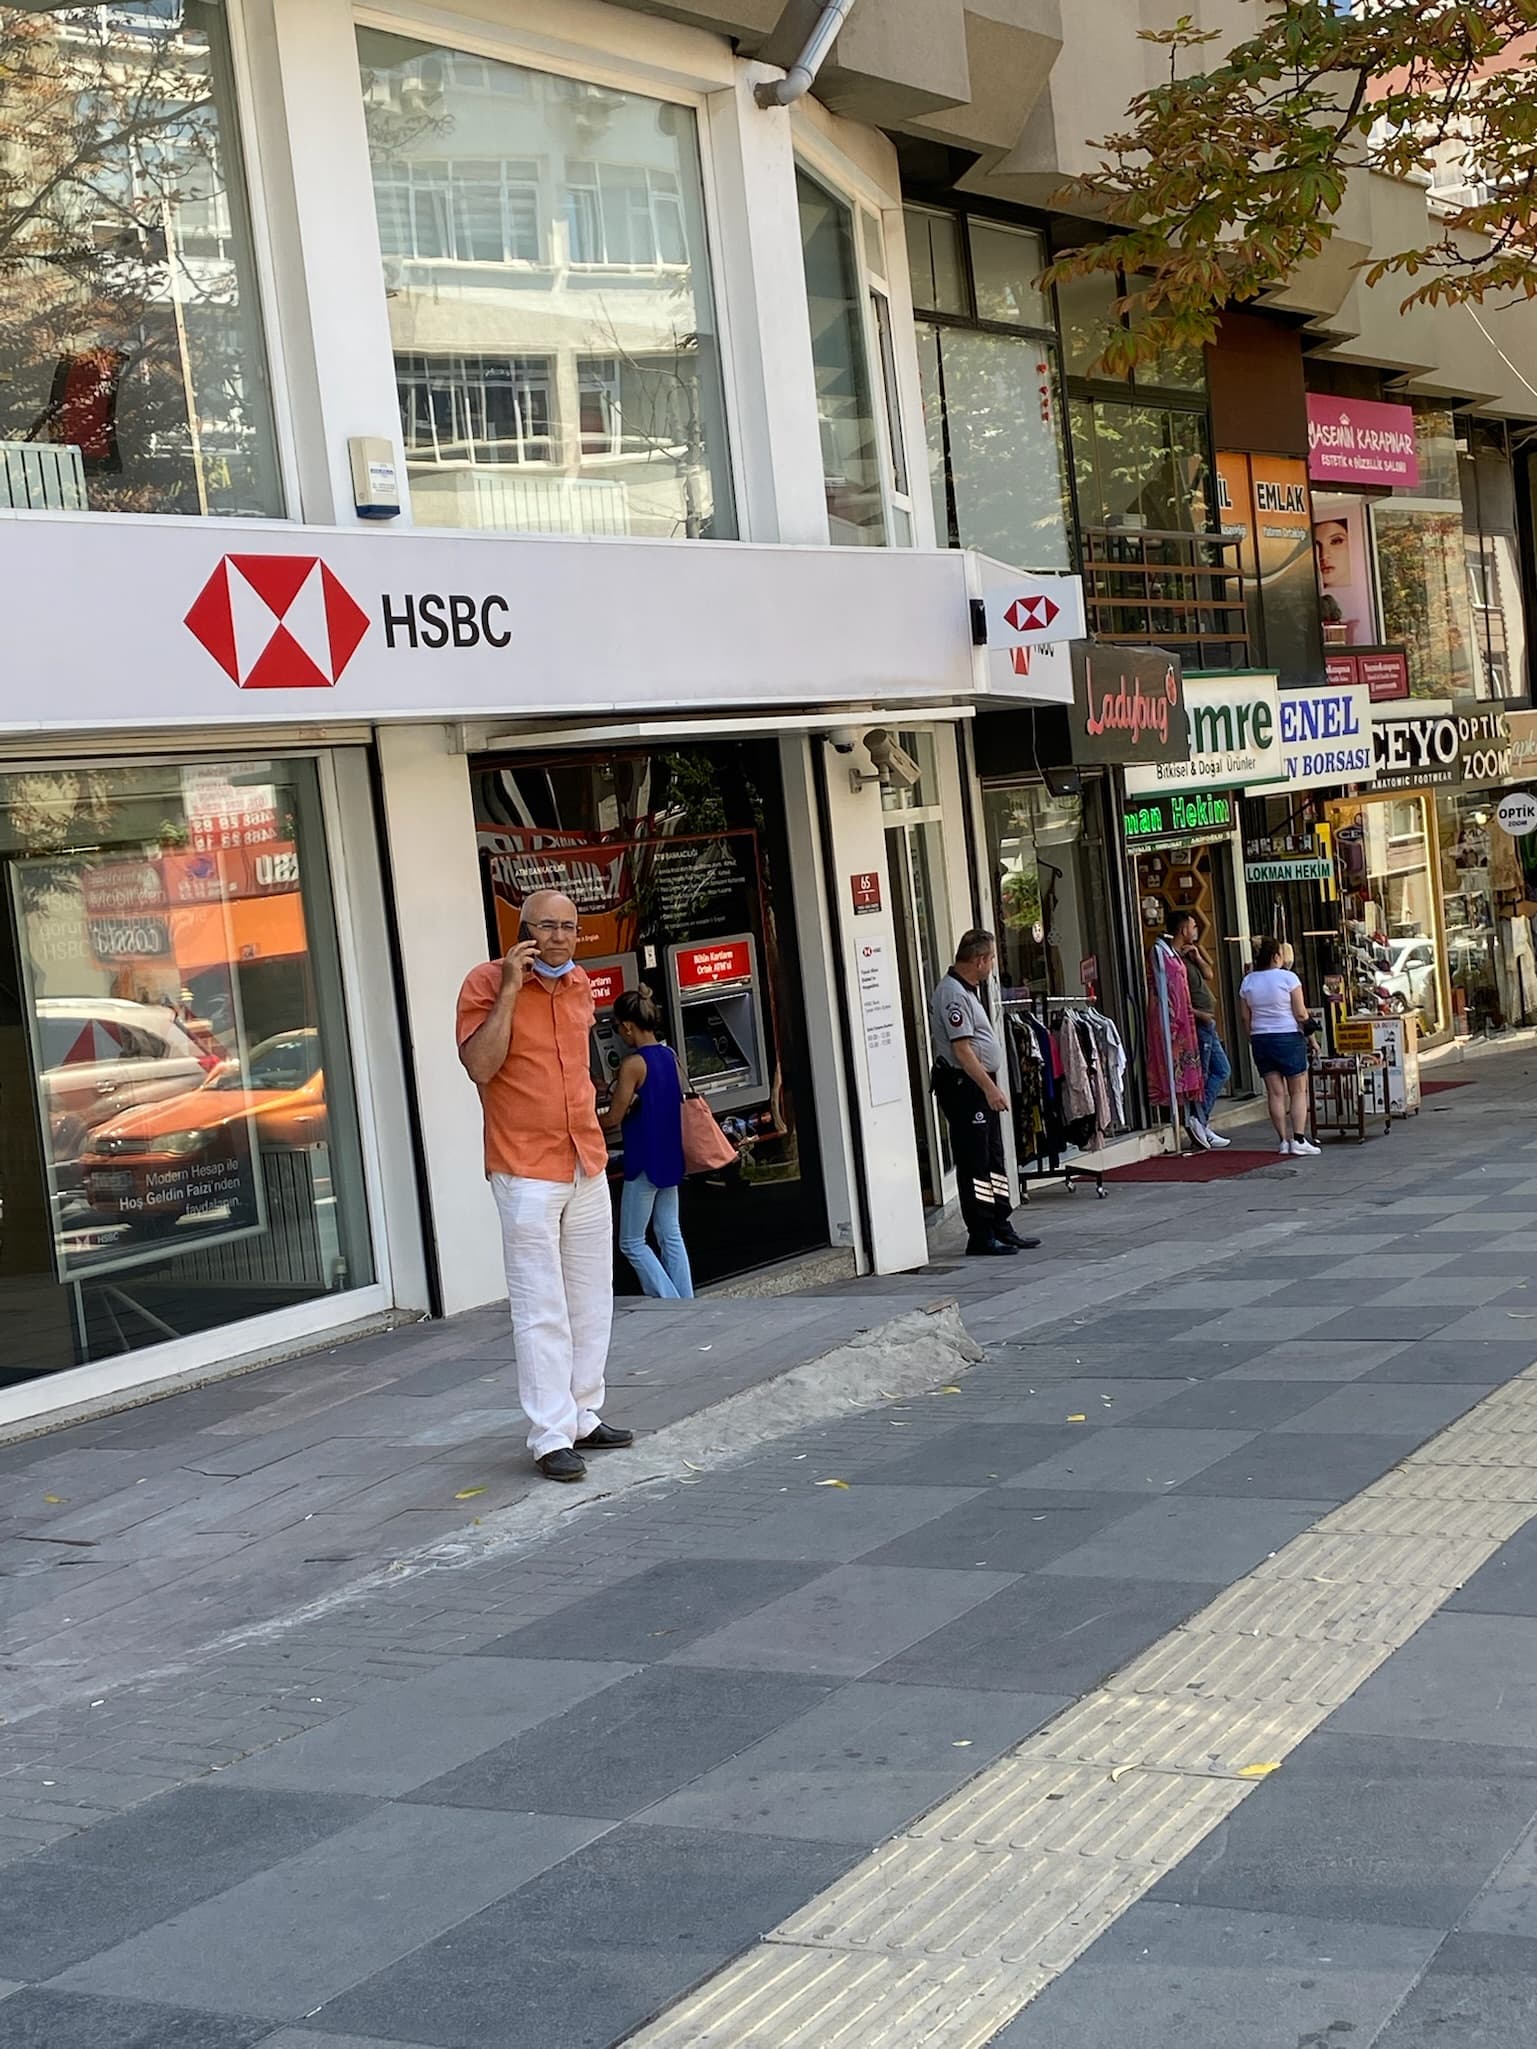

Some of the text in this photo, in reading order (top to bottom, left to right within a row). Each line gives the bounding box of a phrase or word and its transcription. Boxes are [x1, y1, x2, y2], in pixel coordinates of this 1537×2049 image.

[1255, 481, 1307, 515] EMLAK
[382, 594, 513, 649] HSBC
[1085, 656, 1169, 744] Ladybug
[1280, 696, 1359, 743] ENEL
[1458, 712, 1506, 742] OPTİK
[1371, 718, 1459, 771] CEYO
[1156, 755, 1256, 780] Bitkisel & Doğal Ürünler
[1302, 748, 1371, 776] BORSASI
[1463, 748, 1511, 780] ZOOM
[1171, 793, 1230, 829] Hekim
[1498, 804, 1536, 819] OPTİK
[860, 875, 871, 890] 65
[1247, 859, 1330, 883] LOKMAN HEKİM
[145, 1168, 189, 1187] Modern
[191, 1164, 225, 1181] Hesap
[226, 1158, 239, 1171] ile
[119, 1175, 241, 1213] Hoş Geldin Faizi'nden
[96, 1231, 119, 1244] HSBC
